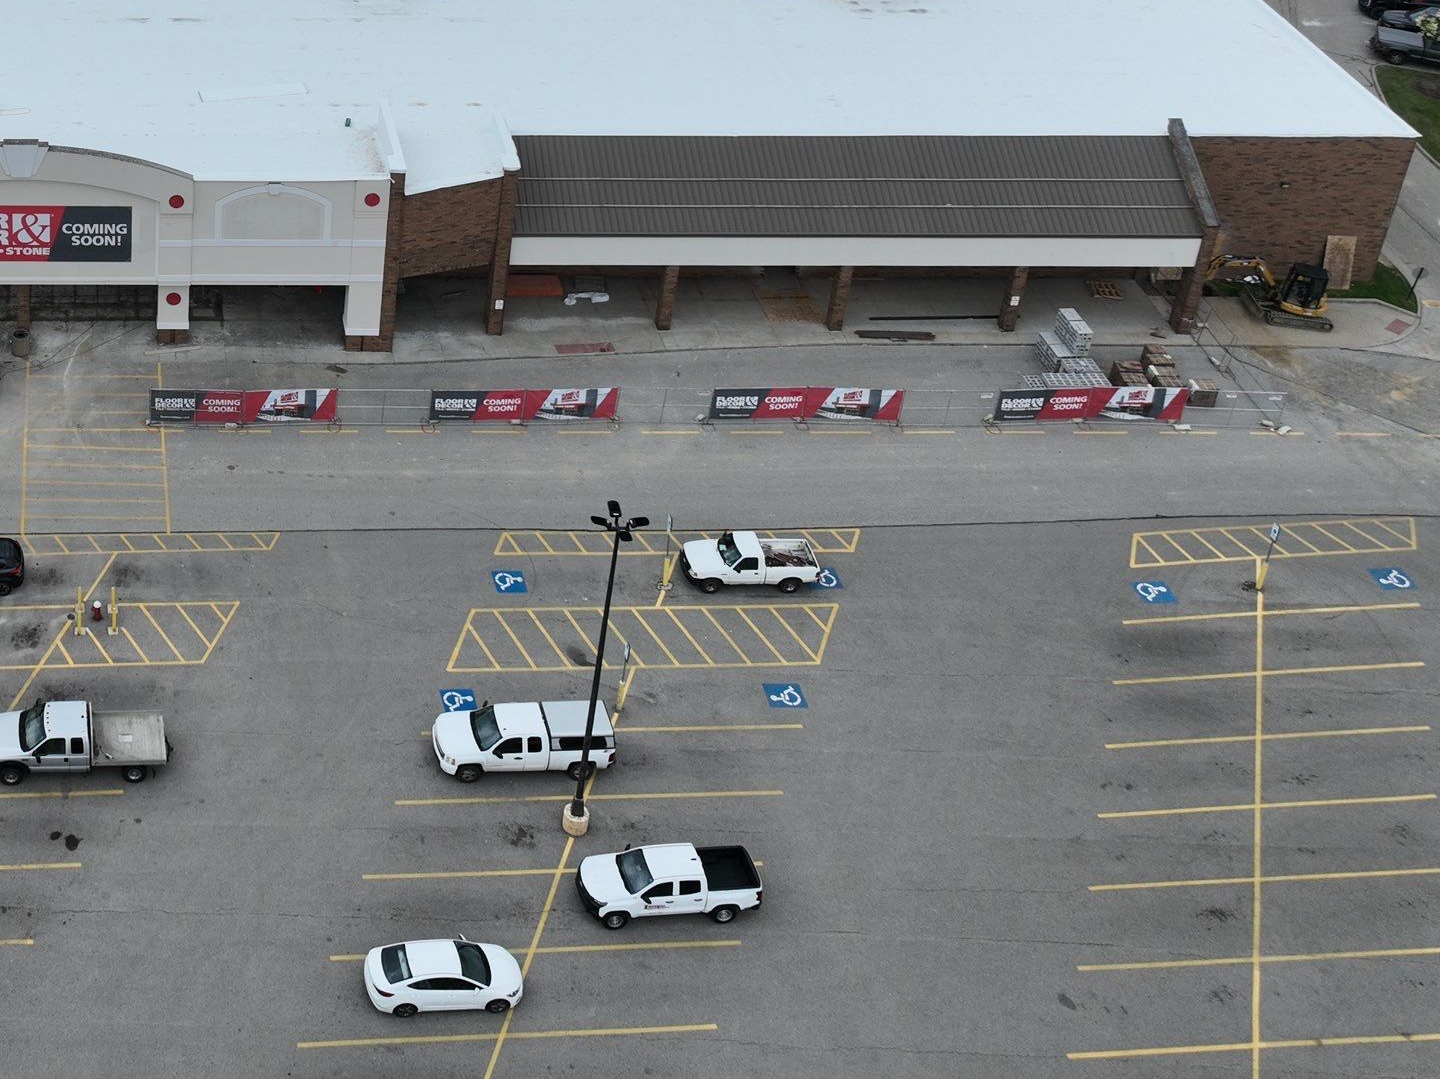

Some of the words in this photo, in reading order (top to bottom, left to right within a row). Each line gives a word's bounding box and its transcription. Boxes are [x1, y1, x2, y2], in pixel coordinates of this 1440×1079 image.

[12, 213, 51, 246] &
[62, 223, 128, 235] COMING
[71, 235, 122, 246] SOON!
[5, 247, 51, 255] STONE
[483, 398, 521, 406] COMING
[764, 396, 803, 404] COMING
[1049, 396, 1088, 404] COMING
[487, 405, 517, 413] SOON!
[768, 403, 799, 411] SOON!
[1053, 403, 1083, 411] SOON!
